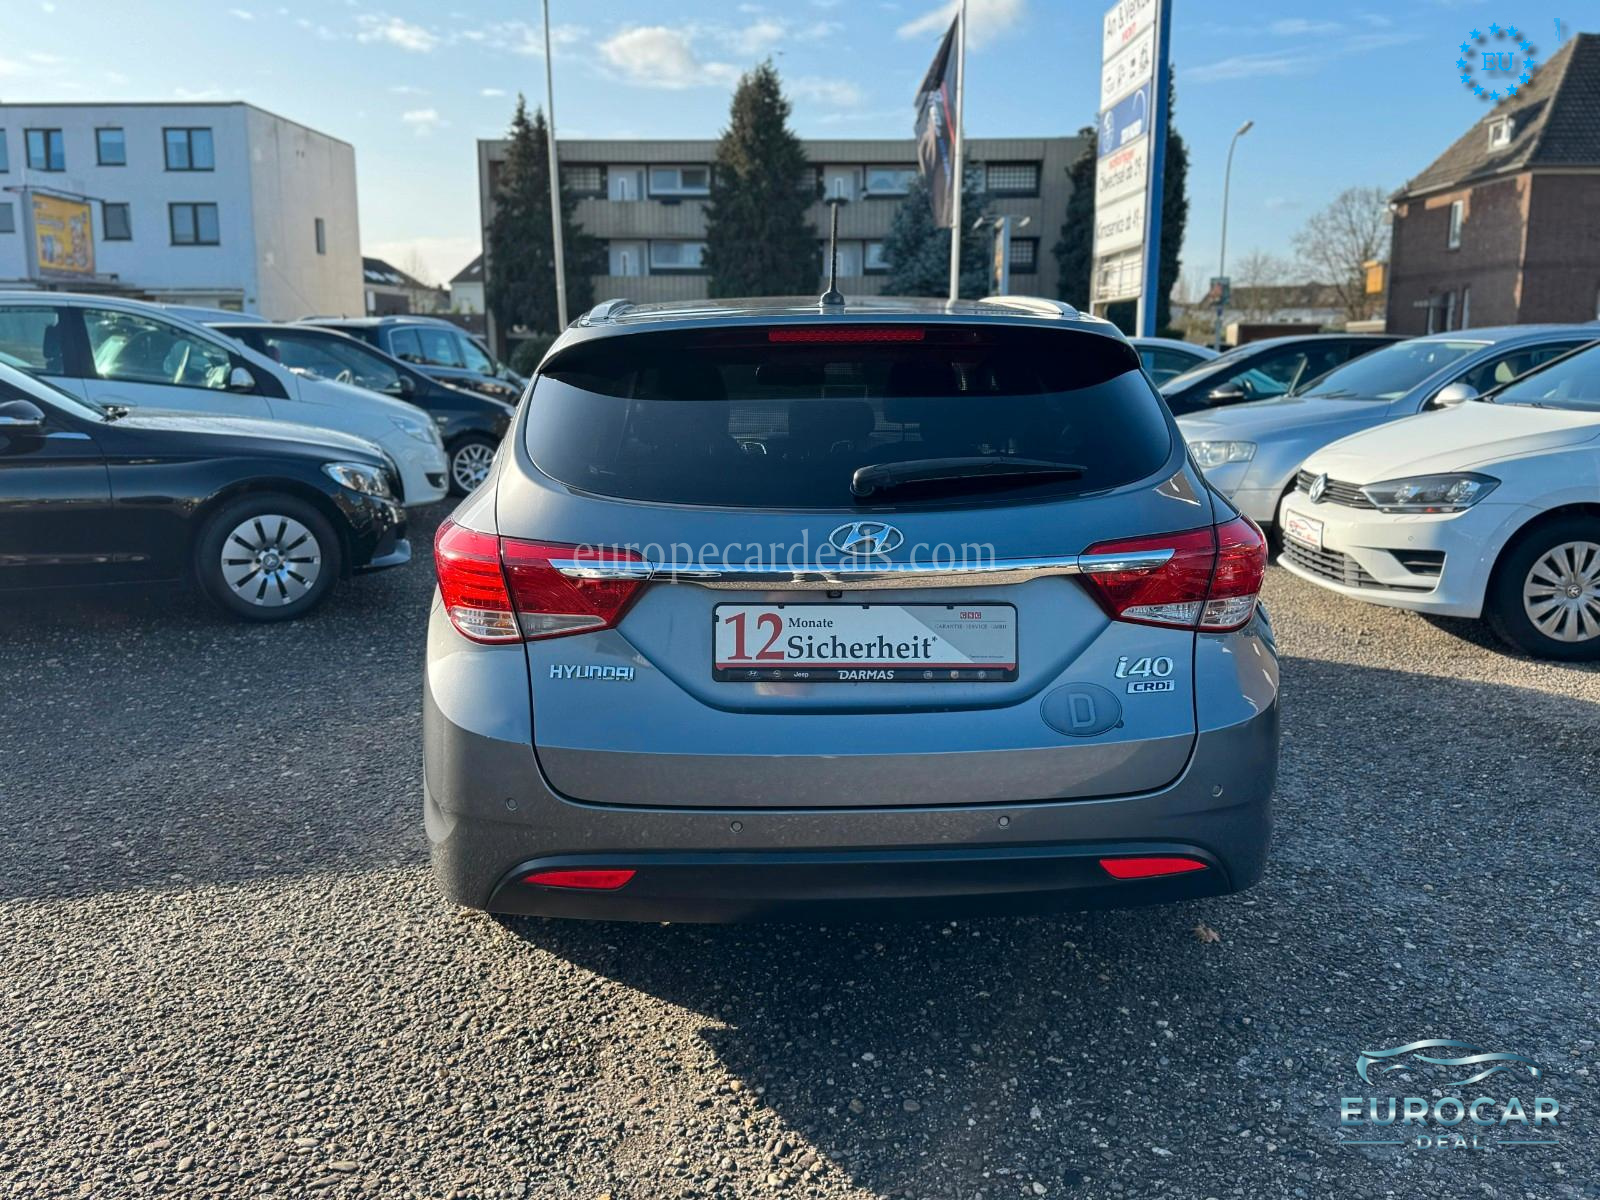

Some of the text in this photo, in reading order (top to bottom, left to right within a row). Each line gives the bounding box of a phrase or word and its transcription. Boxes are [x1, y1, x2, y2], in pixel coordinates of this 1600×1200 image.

[725, 612, 834, 660] 12 Monate
[550, 664, 634, 681] HYUNDAI
[838, 670, 895, 680] DARMAS
[1115, 656, 1173, 678] i40
[1133, 681, 1170, 692] CRDi
[1068, 693, 1096, 728] D
